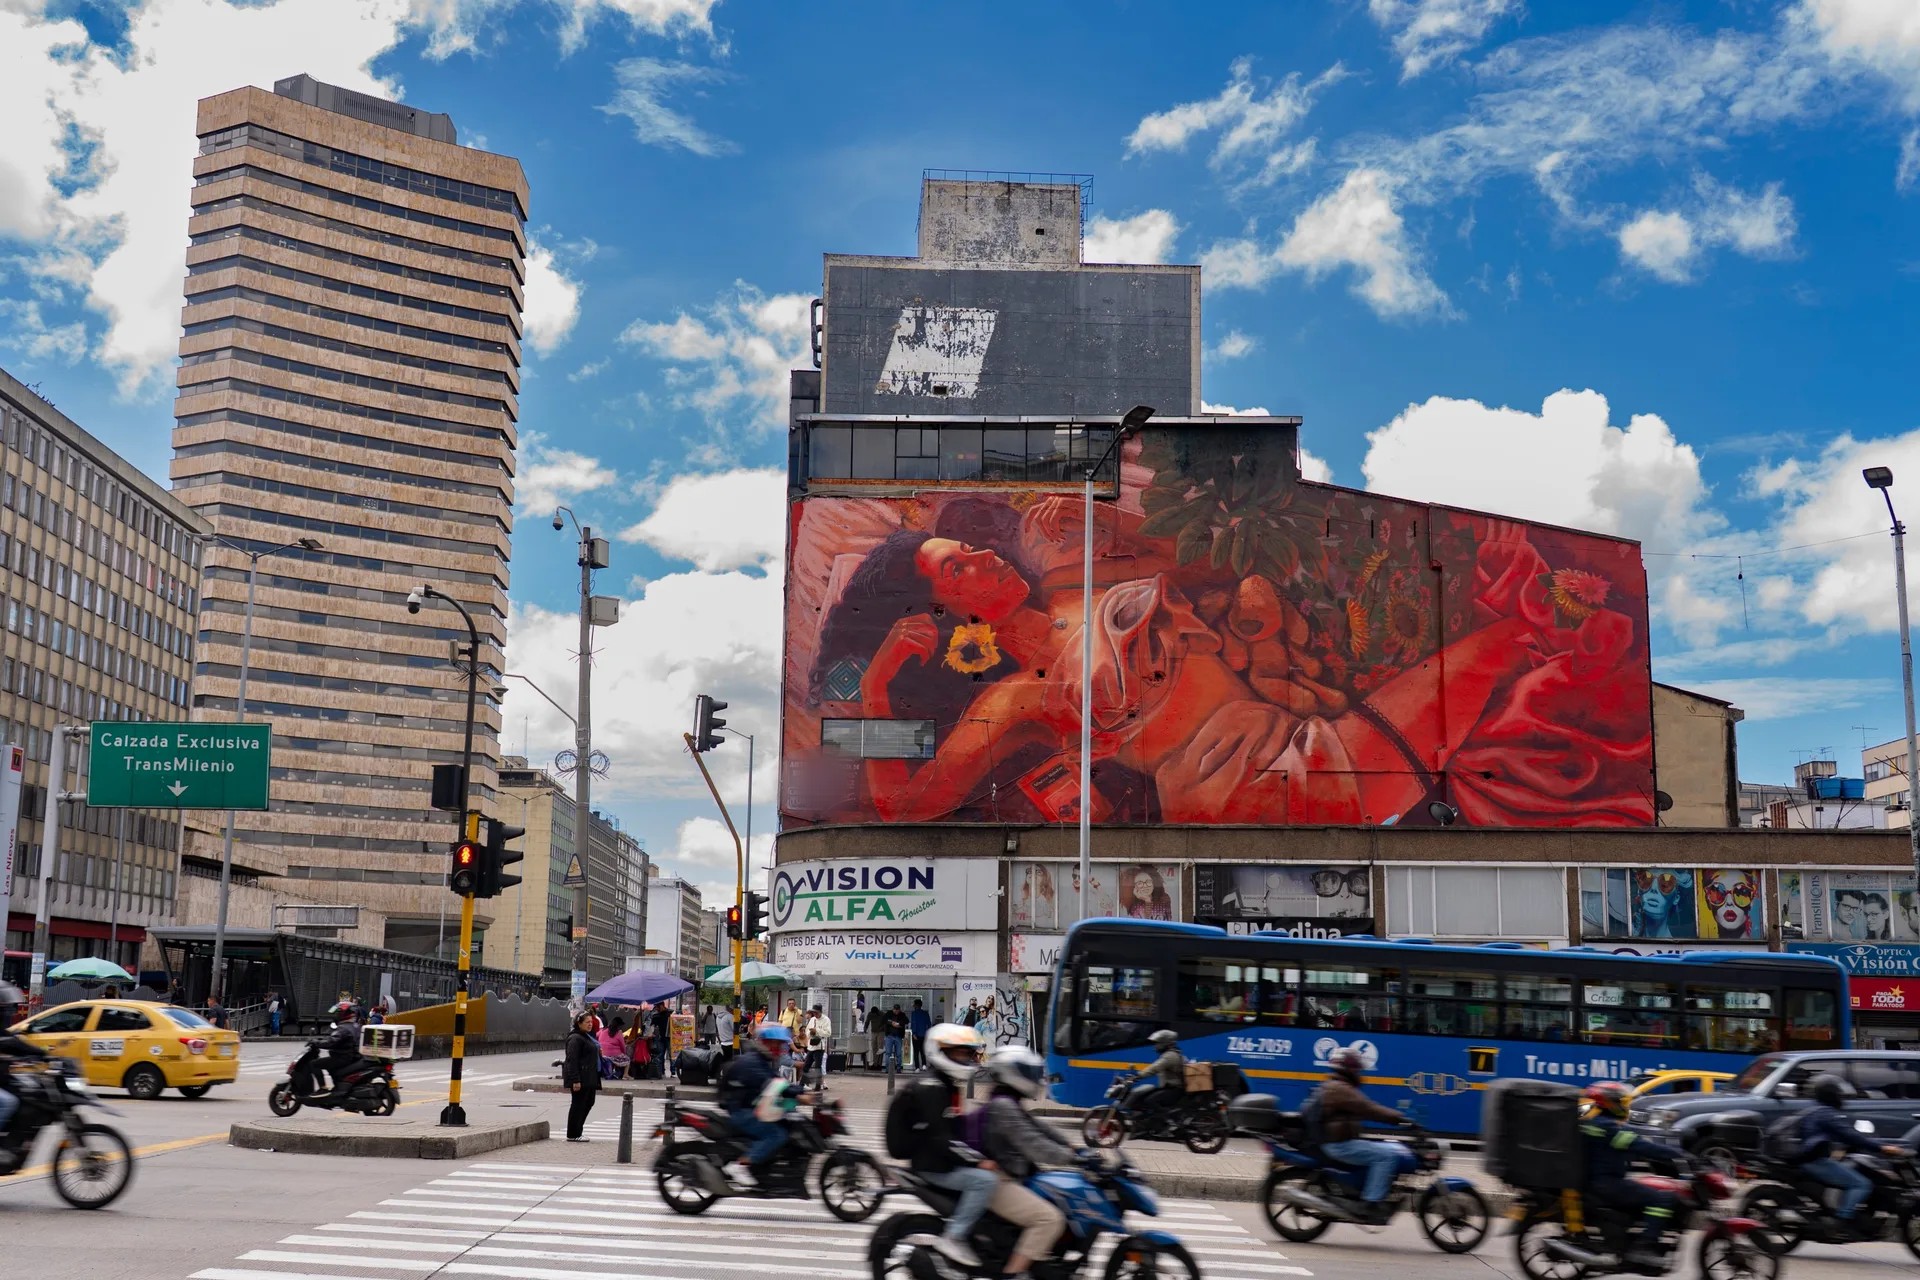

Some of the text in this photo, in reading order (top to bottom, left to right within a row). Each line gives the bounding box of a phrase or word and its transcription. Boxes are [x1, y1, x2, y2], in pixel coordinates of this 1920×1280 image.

[100, 732, 260, 749] Calzada Exclusiva
[123, 756, 235, 772] TransMilenio
[6, 828, 15, 871] Nieves
[806, 866, 934, 891] VISION
[804, 897, 936, 923] ALFA Houston
[780, 934, 941, 947] LENTES DE ALTA TECNOLOGIA
[1876, 948, 1912, 956] OPTICA
[1846, 955, 1908, 970] Visión
[1871, 995, 1905, 1004] TODO
